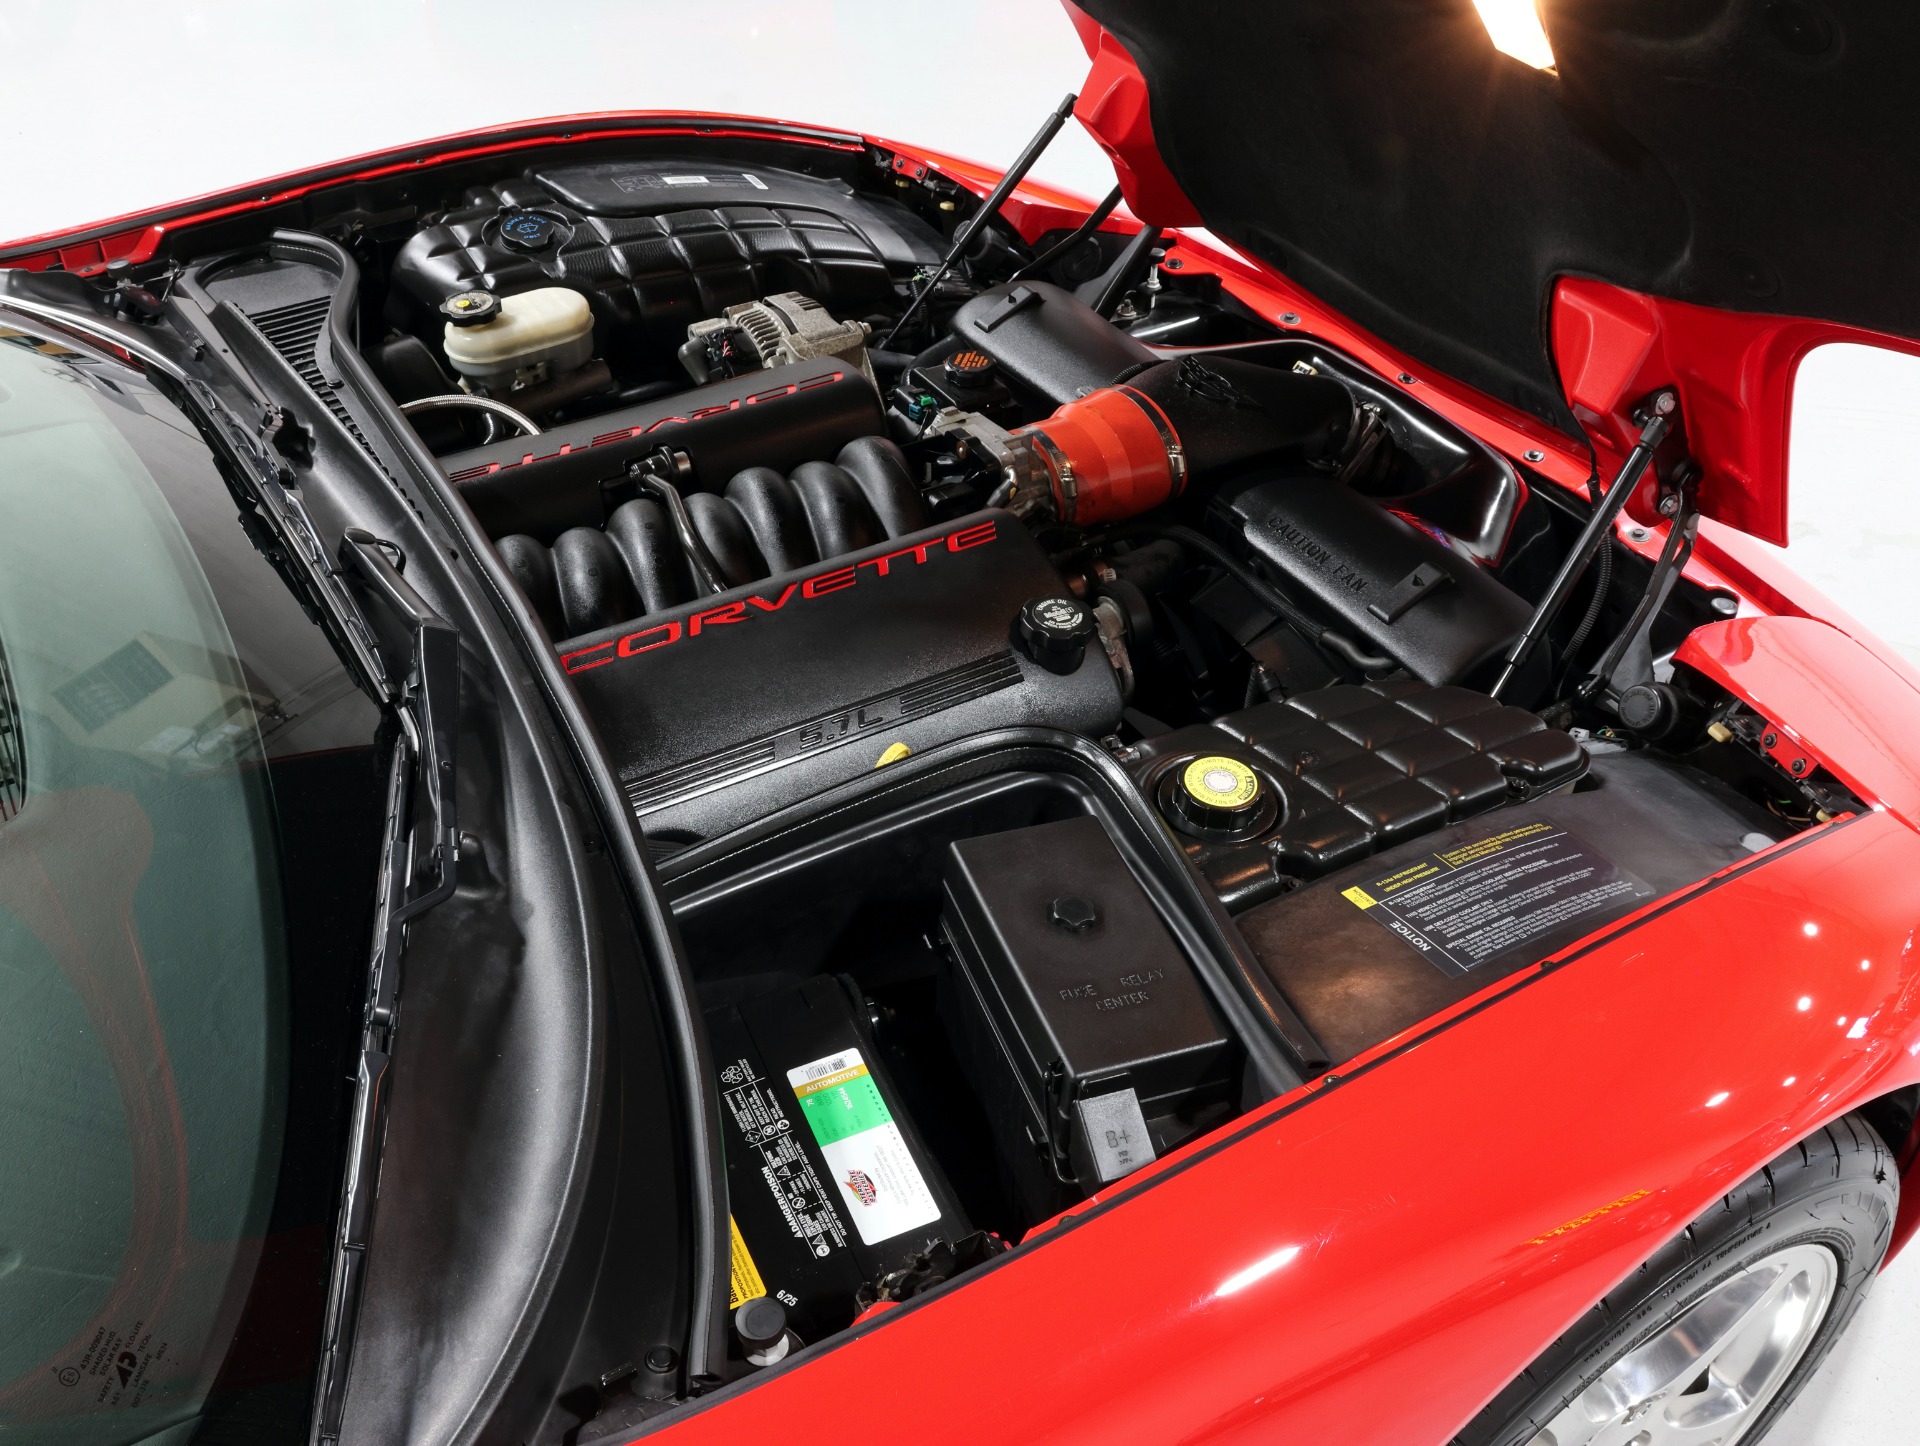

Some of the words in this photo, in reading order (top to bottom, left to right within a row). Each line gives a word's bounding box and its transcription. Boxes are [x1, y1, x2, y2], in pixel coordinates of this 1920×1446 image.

[448, 371, 843, 482] CORVETTE
[1268, 515, 1331, 564] CAUTION
[1334, 563, 1369, 593] FAN
[560, 520, 997, 675] CORVETTE
[1383, 882, 1402, 892] UNDER
[1400, 877, 1415, 885] HIGH
[1412, 866, 1440, 879] PRESSURE
[1392, 862, 1427, 879] REFRIGERANT
[1403, 882, 1436, 898] REFRIGERANT
[1389, 920, 1432, 952] NOTICE
[1445, 937, 1467, 949] SPECIAL
[1465, 929, 1484, 940] ENGINE
[1491, 915, 1516, 928] REQUIRED
[1059, 984, 1097, 1000] FUSE
[1119, 968, 1163, 987] RELAY
[1095, 991, 1149, 1010] CENTER
[806, 1068, 860, 1092] AUTOMOTIVE
[770, 1107, 779, 1119] READ
[806, 1098, 814, 1106] 78
[801, 1154, 809, 1164] AND
[805, 1164, 815, 1176] TIGHT
[812, 1176, 822, 1188] CAPS
[818, 1188, 827, 1199] VENT
[849, 1171, 869, 1206] INTERSTATE
[856, 1170, 876, 1203] BATTERIES
[761, 1166, 799, 1232] DANGER/POISON
[824, 1199, 834, 1211] KEEP
[834, 1219, 843, 1228] NOT
[839, 1228, 847, 1236] DO
[1715, 1226, 1763, 1260] TEMPERATURE
[730, 1267, 748, 1299] PROPOSITION
[774, 1289, 799, 1308] 6/25
[89, 1347, 108, 1375] SHADED
[104, 1331, 116, 1347] HUD
[99, 1352, 115, 1376] SOLAR
[111, 1338, 122, 1353] RAY
[97, 1375, 114, 1403] SAFETY
